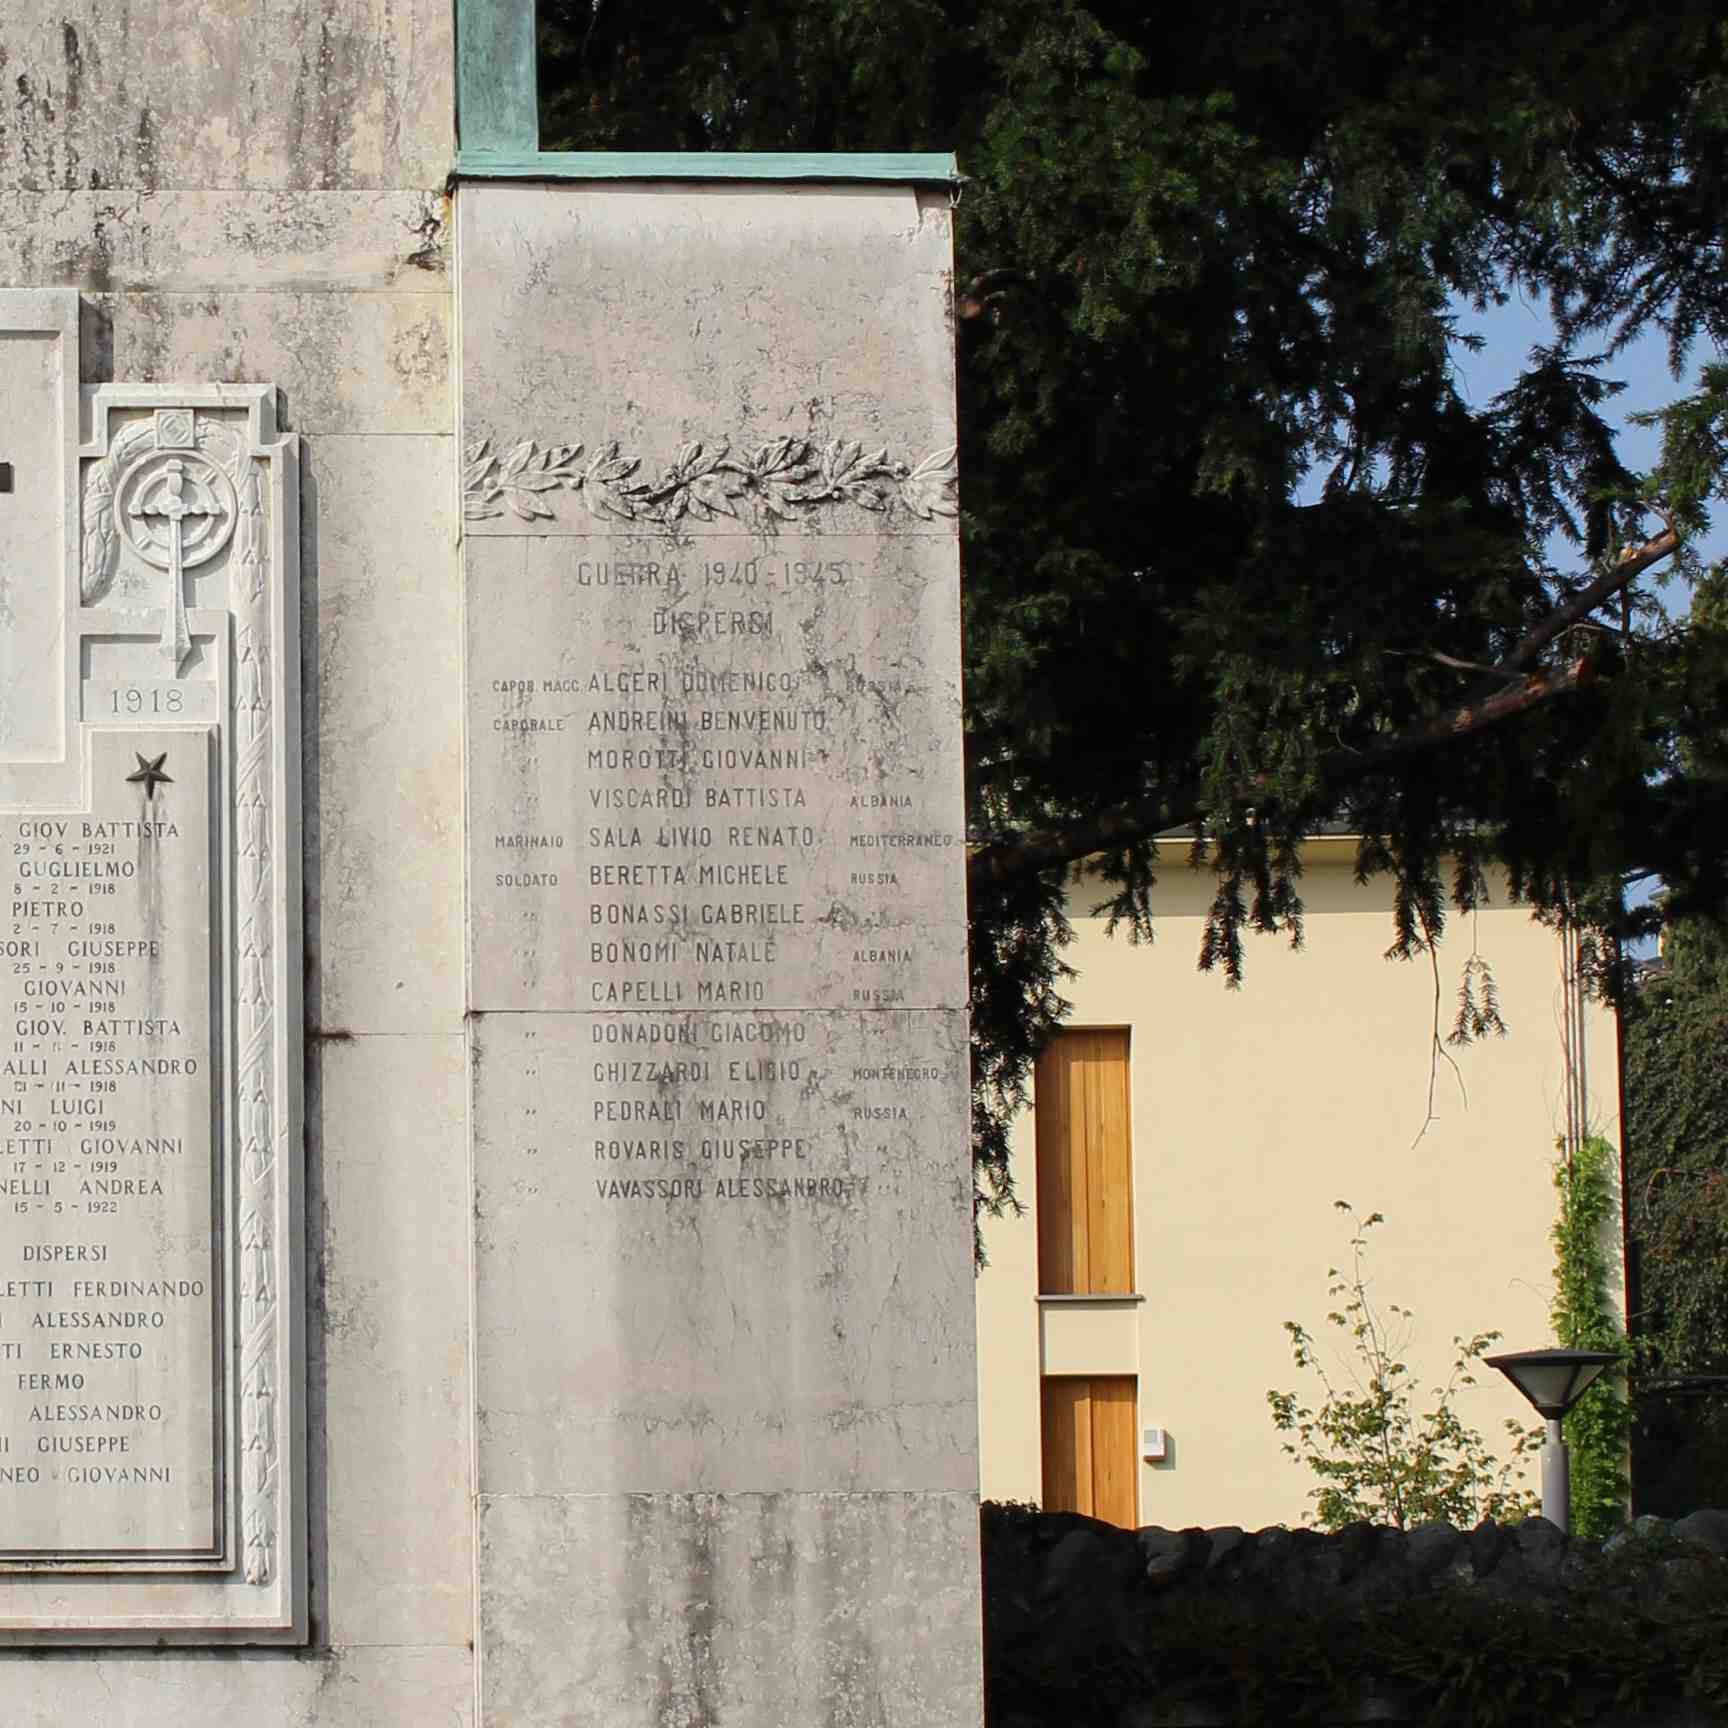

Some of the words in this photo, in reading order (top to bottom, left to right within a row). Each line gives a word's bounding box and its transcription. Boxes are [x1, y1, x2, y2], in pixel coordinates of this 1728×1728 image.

[111, 688, 184, 713] 1918
[589, 788, 691, 809] VISCARDI
[705, 788, 807, 809] BATTISTA
[849, 794, 913, 808] ALBANIA
[81, 821, 180, 839] BATTISTA
[495, 835, 565, 850] MARINAIO
[589, 827, 642, 848] SALA
[658, 827, 713, 847] LIVIO
[728, 826, 814, 847] RENATO
[849, 834, 953, 848] MEDITERRANEO
[18, 860, 136, 879] GUGLIELMO
[495, 873, 559, 888] SOLDATO
[589, 865, 687, 886] BERETTA
[698, 864, 789, 886] MICHELE
[850, 872, 899, 886] RUSSIA
[11, 901, 85, 918] PIETRO
[590, 903, 689, 925] BONASSI
[701, 903, 805, 924] GABRIELE
[67, 940, 161, 958] GIUSEPPE
[591, 942, 678, 963] BONOMI
[695, 942, 777, 963] NATALE
[852, 950, 912, 963] ALBANIA
[23, 979, 126, 997] GIOVANNI
[591, 981, 682, 1002] CAPELLI
[697, 981, 765, 1002] MARIO
[15, 1019, 67, 1037] GIOV.
[83, 1019, 182, 1037] BATTISTA
[64, 1058, 198, 1076] ALESSANDRO
[50, 1098, 105, 1115] LUIGI
[593, 1100, 681, 1121] PEDRALI
[700, 1100, 766, 1121] MARIO
[854, 1107, 907, 1121] RUSSIA
[80, 1138, 183, 1155] GIOVANNI
[594, 1140, 684, 1161] ROVARIS
[701, 1139, 807, 1160] GIUSEPPE
[79, 1178, 164, 1196] ANDREA
[23, 1244, 108, 1262] DISPERSI
[73, 1280, 205, 1297] FERDINANDO
[31, 1311, 165, 1329] ALESSANDRO
[50, 1342, 143, 1360] ERNESTO
[17, 1373, 85, 1391] FERMO
[28, 1404, 162, 1421] ALESSANDRO
[37, 1435, 130, 1453] GIUSEPPE
[68, 1466, 171, 1484] GIOVANNI
